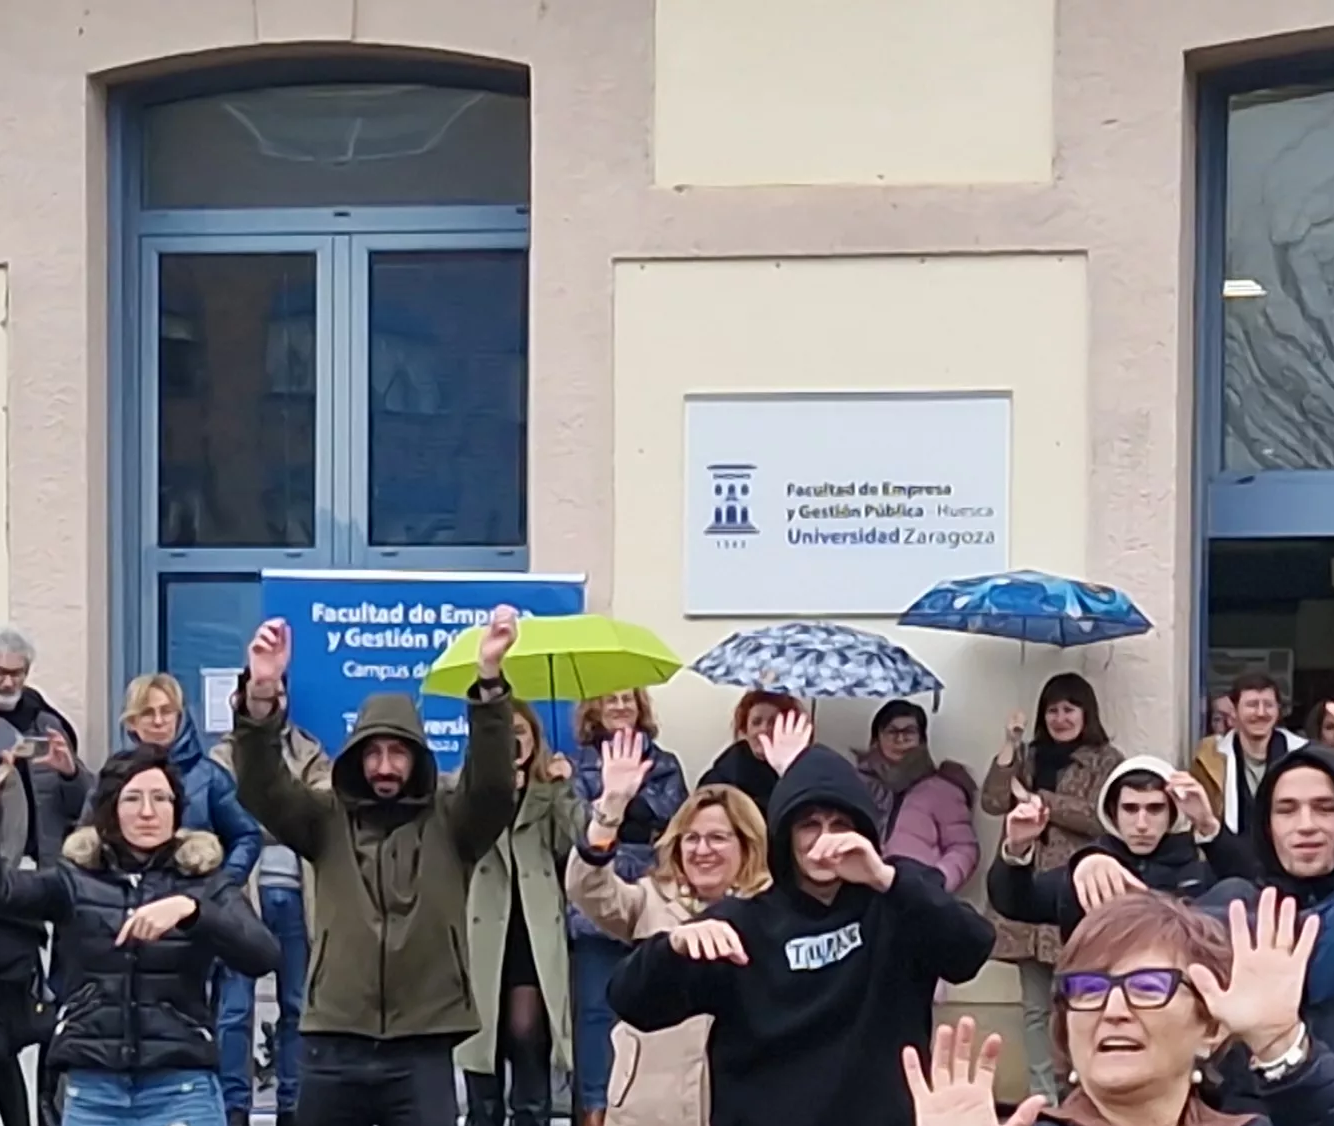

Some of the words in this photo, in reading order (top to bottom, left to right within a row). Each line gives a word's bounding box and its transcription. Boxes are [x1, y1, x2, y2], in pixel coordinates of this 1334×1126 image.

[787, 482, 855, 497] Facultad
[859, 482, 878, 496] de
[882, 482, 951, 499] Empresa
[787, 508, 795, 521] y
[799, 504, 861, 518] Gestión
[865, 503, 923, 518] Pública
[937, 504, 994, 517] Huesca
[788, 527, 900, 544] Universidad
[904, 528, 995, 549] Zaragoza
[312, 602, 403, 624] Facultad
[408, 603, 436, 624] de
[441, 603, 534, 625] Empa
[327, 632, 341, 652] y
[345, 627, 428, 648] Gestión
[343, 661, 409, 681] Campus
[412, 661, 430, 679] d
